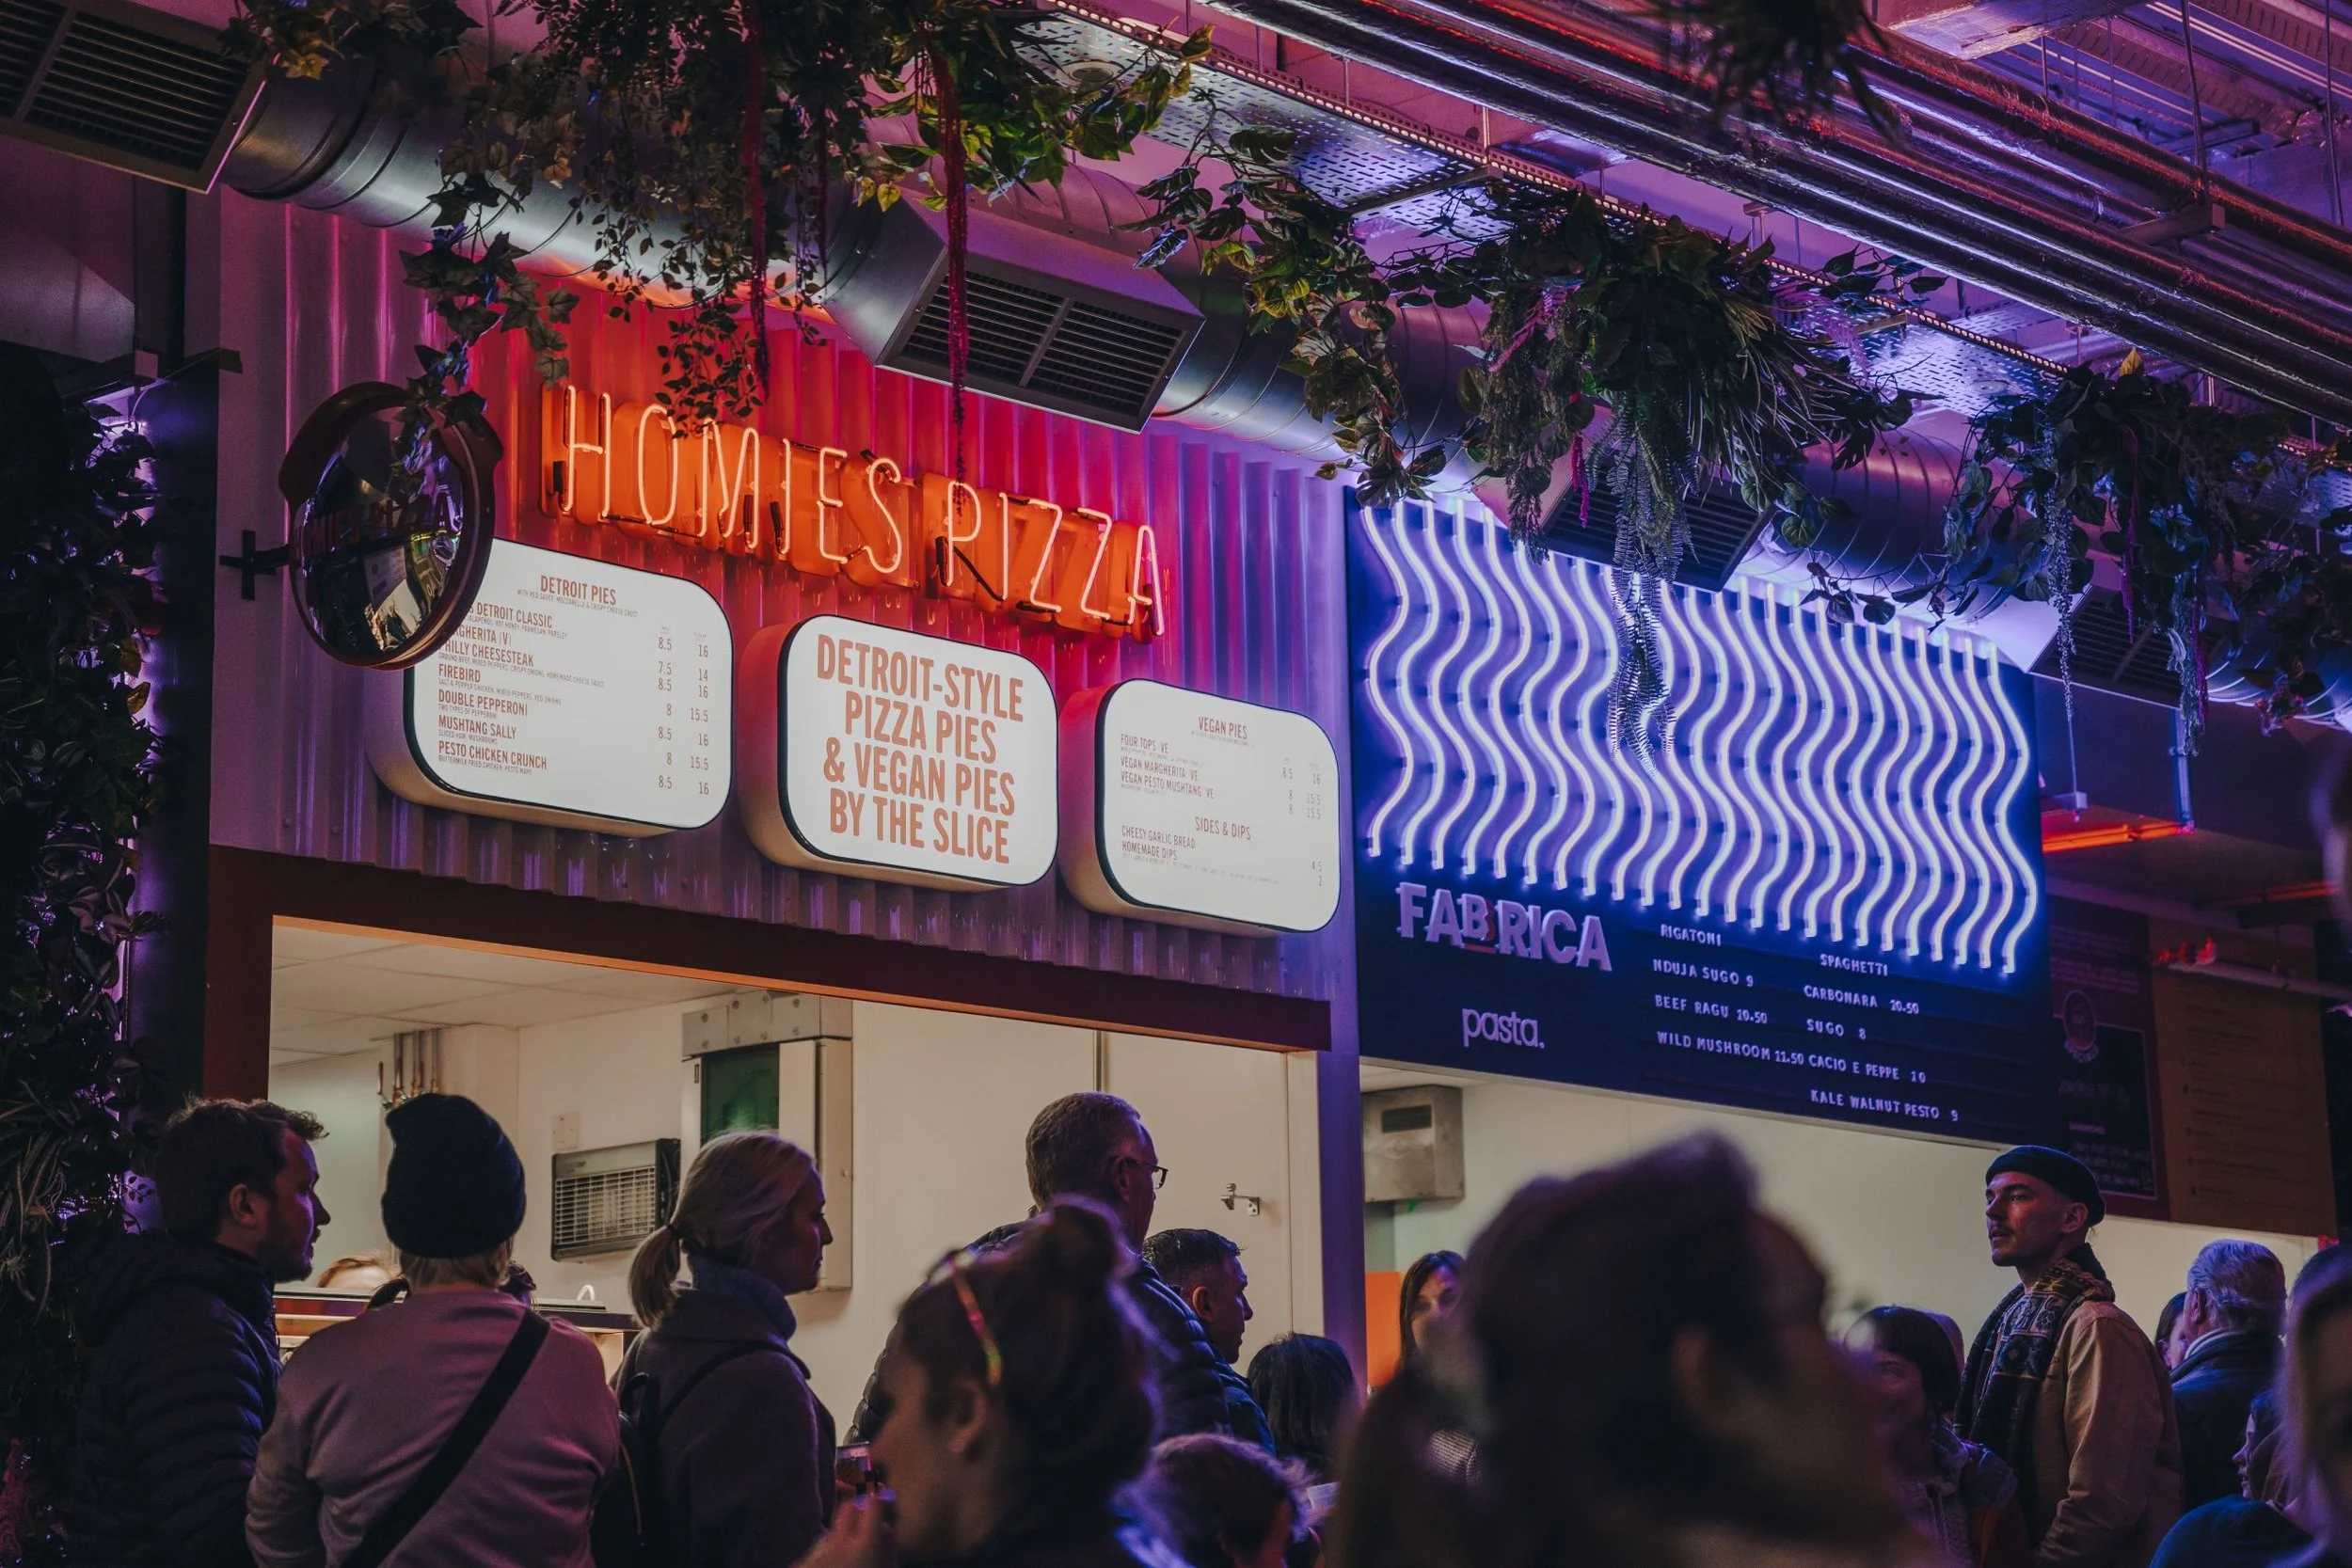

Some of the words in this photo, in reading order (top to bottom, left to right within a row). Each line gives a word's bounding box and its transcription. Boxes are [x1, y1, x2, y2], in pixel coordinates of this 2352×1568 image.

[564, 383, 902, 574] HOMIES
[942, 480, 1166, 637] PIZZA
[541, 575, 587, 600] DETROIT
[591, 585, 616, 606] PIES
[477, 602, 513, 620] DETROIT
[516, 609, 552, 629] CLASSIC
[500, 631, 512, 645] (V)
[659, 637, 672, 651] 8.5
[698, 644, 708, 657] 16
[439, 641, 469, 656] HILLY
[472, 643, 534, 668] CHEESESTEAK
[438, 663, 481, 683] FIREBIRD
[659, 661, 672, 674] 7.5
[698, 668, 708, 681] 14
[817, 633, 1024, 722] DETROIT-STYLE
[659, 677, 672, 691] 8.5
[698, 685, 708, 698] 16
[438, 689, 474, 708] DOUBLE
[477, 696, 528, 717] PEPPERONI
[666, 704, 672, 717] 8
[691, 707, 708, 722] 15.5
[438, 714, 487, 736] MUSHTANG
[490, 723, 516, 739] SALLY
[659, 726, 672, 740] 8.5
[698, 733, 708, 747] 16
[845, 689, 927, 751] PIZZA
[936, 709, 996, 765] PIES
[1198, 716, 1226, 735] VEGAN
[1229, 721, 1248, 740] PIES
[438, 740, 467, 757] PESTO
[469, 745, 508, 764] CHICKEN
[511, 752, 547, 770] CRUNCH
[1120, 733, 1137, 748] FOUR
[1140, 736, 1156, 752] TOPS
[666, 752, 672, 765] 8
[691, 755, 709, 770] 15.5
[1120, 755, 1142, 769] VEGAN
[1144, 759, 1186, 778] MARGHERITA
[659, 775, 673, 789] 8.5
[699, 782, 709, 795] 16
[823, 736, 845, 784] &
[853, 741, 946, 803] VEGAN
[955, 763, 1015, 816] PIES
[1120, 770, 1142, 784] VEGAN
[1144, 774, 1165, 789] PESTO
[1167, 779, 1201, 798] MUSHTANG
[830, 786, 866, 837] BY
[872, 795, 925, 848] THE
[933, 807, 1009, 864] SLICE
[1121, 825, 1146, 841] CHEESY
[1148, 830, 1172, 846] GARLIC
[1173, 834, 1196, 848] BREAD
[1195, 816, 1220, 835] SIDES
[1222, 821, 1229, 836] &
[1231, 823, 1251, 840] DIPS
[1121, 840, 1160, 858] HOMEMADE
[1161, 847, 1178, 861] DIPS
[1397, 881, 1613, 973] FABRICA
[1661, 924, 1722, 947] RIGATONI
[1653, 958, 1697, 977] NDUJA
[1702, 966, 1740, 986] SUGO
[1745, 974, 1754, 988] 9
[1820, 953, 1888, 977] SPAGHETTI
[1655, 994, 1688, 1011] BEEF
[1694, 1001, 1729, 1019] RAGU
[1736, 1008, 1768, 1024] 10.50
[1804, 985, 1878, 1008] CARBONARA
[1889, 999, 1919, 1015] 10.50
[1462, 1007, 1546, 1050] pasta.
[1806, 1018, 1845, 1037] SUGO
[1859, 1027, 1867, 1040] 8
[1657, 1031, 1692, 1048] WILD
[1696, 1037, 1771, 1061] MUSHROOM
[1774, 1050, 1804, 1065] 11.50
[1808, 1054, 1847, 1072] CACIO
[1852, 1061, 1860, 1074] E
[1866, 1063, 1900, 1080] PEPPE
[1911, 1070, 1927, 1084] 10
[1810, 1089, 1845, 1106] KALE
[1850, 1095, 1900, 1114] WALNUT
[1904, 1102, 1940, 1119] PESTO
[1951, 1109, 1959, 1122] 9
